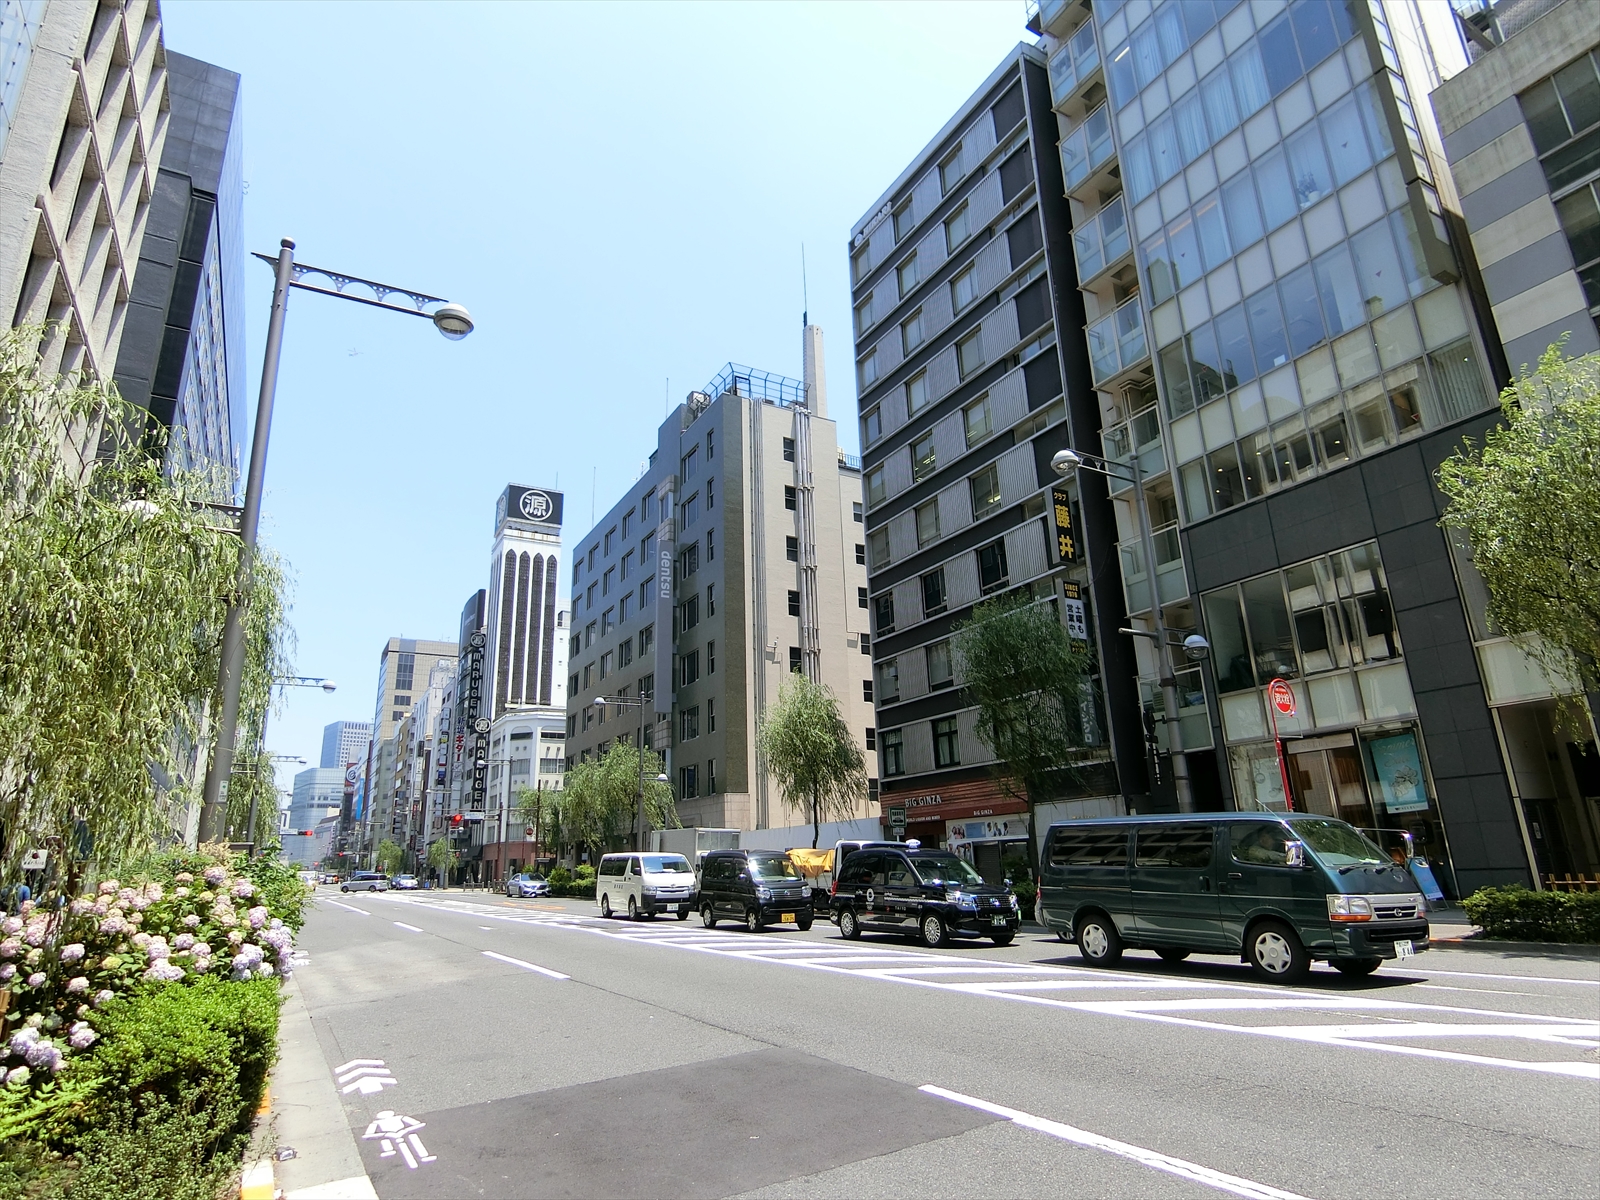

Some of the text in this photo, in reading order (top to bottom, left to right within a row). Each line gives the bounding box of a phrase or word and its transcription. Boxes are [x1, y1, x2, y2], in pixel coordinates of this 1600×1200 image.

[524, 495, 547, 517] 源
[1053, 491, 1067, 501] クラブ
[1054, 504, 1074, 559] 藤井
[660, 550, 672, 599] dentsu
[1066, 603, 1076, 633] 営業中
[1075, 605, 1085, 634] 土曜も
[469, 652, 481, 716] MARUGEN
[473, 739, 486, 810] MAUGEN
[905, 795, 942, 807] BIG GINZA
